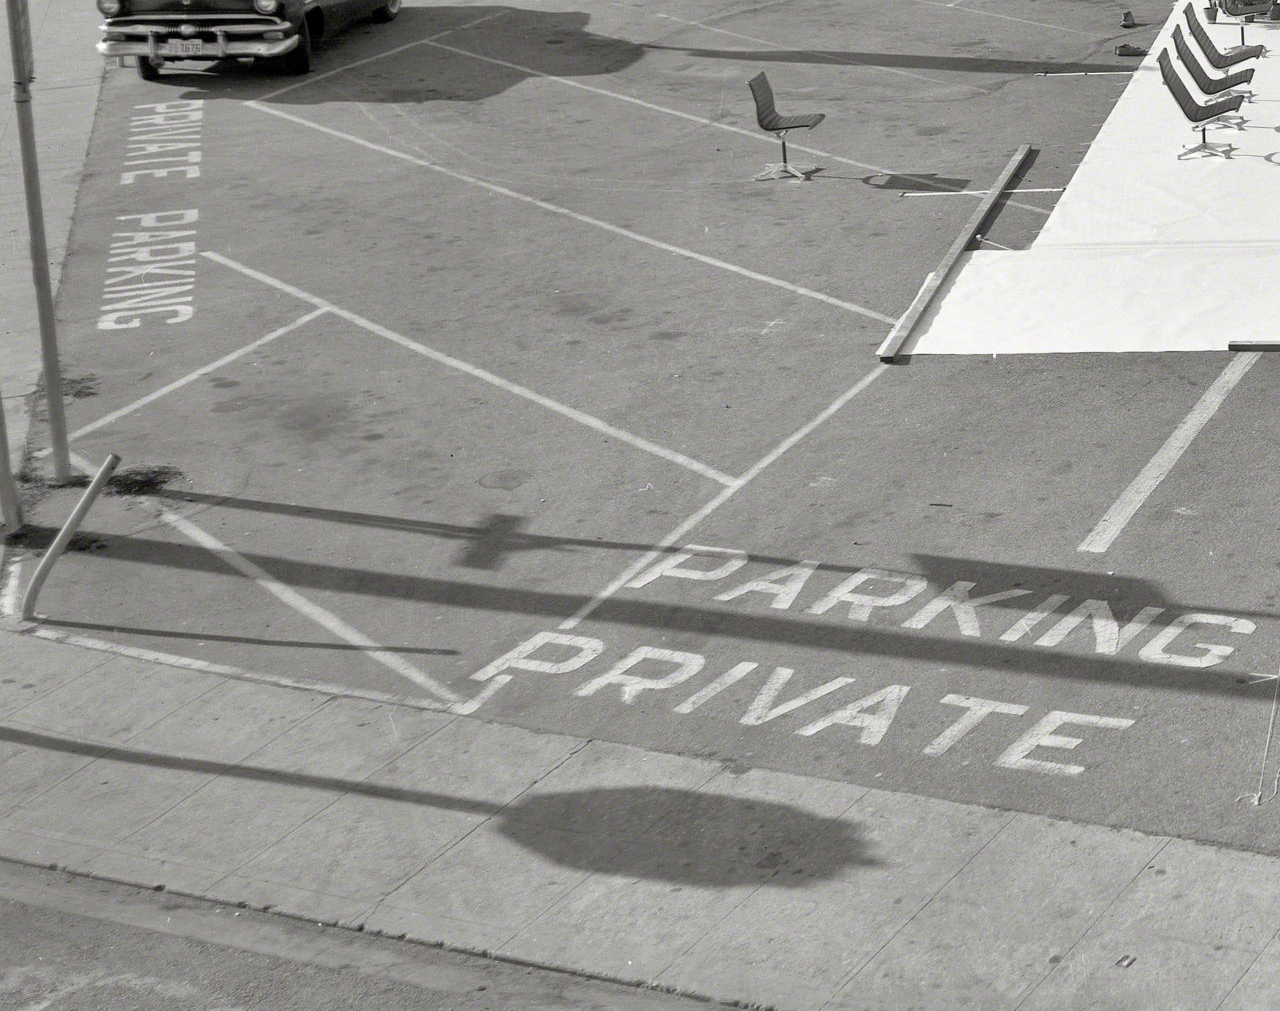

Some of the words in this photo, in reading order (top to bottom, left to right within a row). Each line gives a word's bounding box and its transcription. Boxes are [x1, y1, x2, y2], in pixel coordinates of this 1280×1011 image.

[120, 99, 204, 185] PRIVATE
[97, 208, 199, 330] PARKING
[628, 544, 1258, 670] PARKING
[470, 630, 1136, 776] PRIVATE
